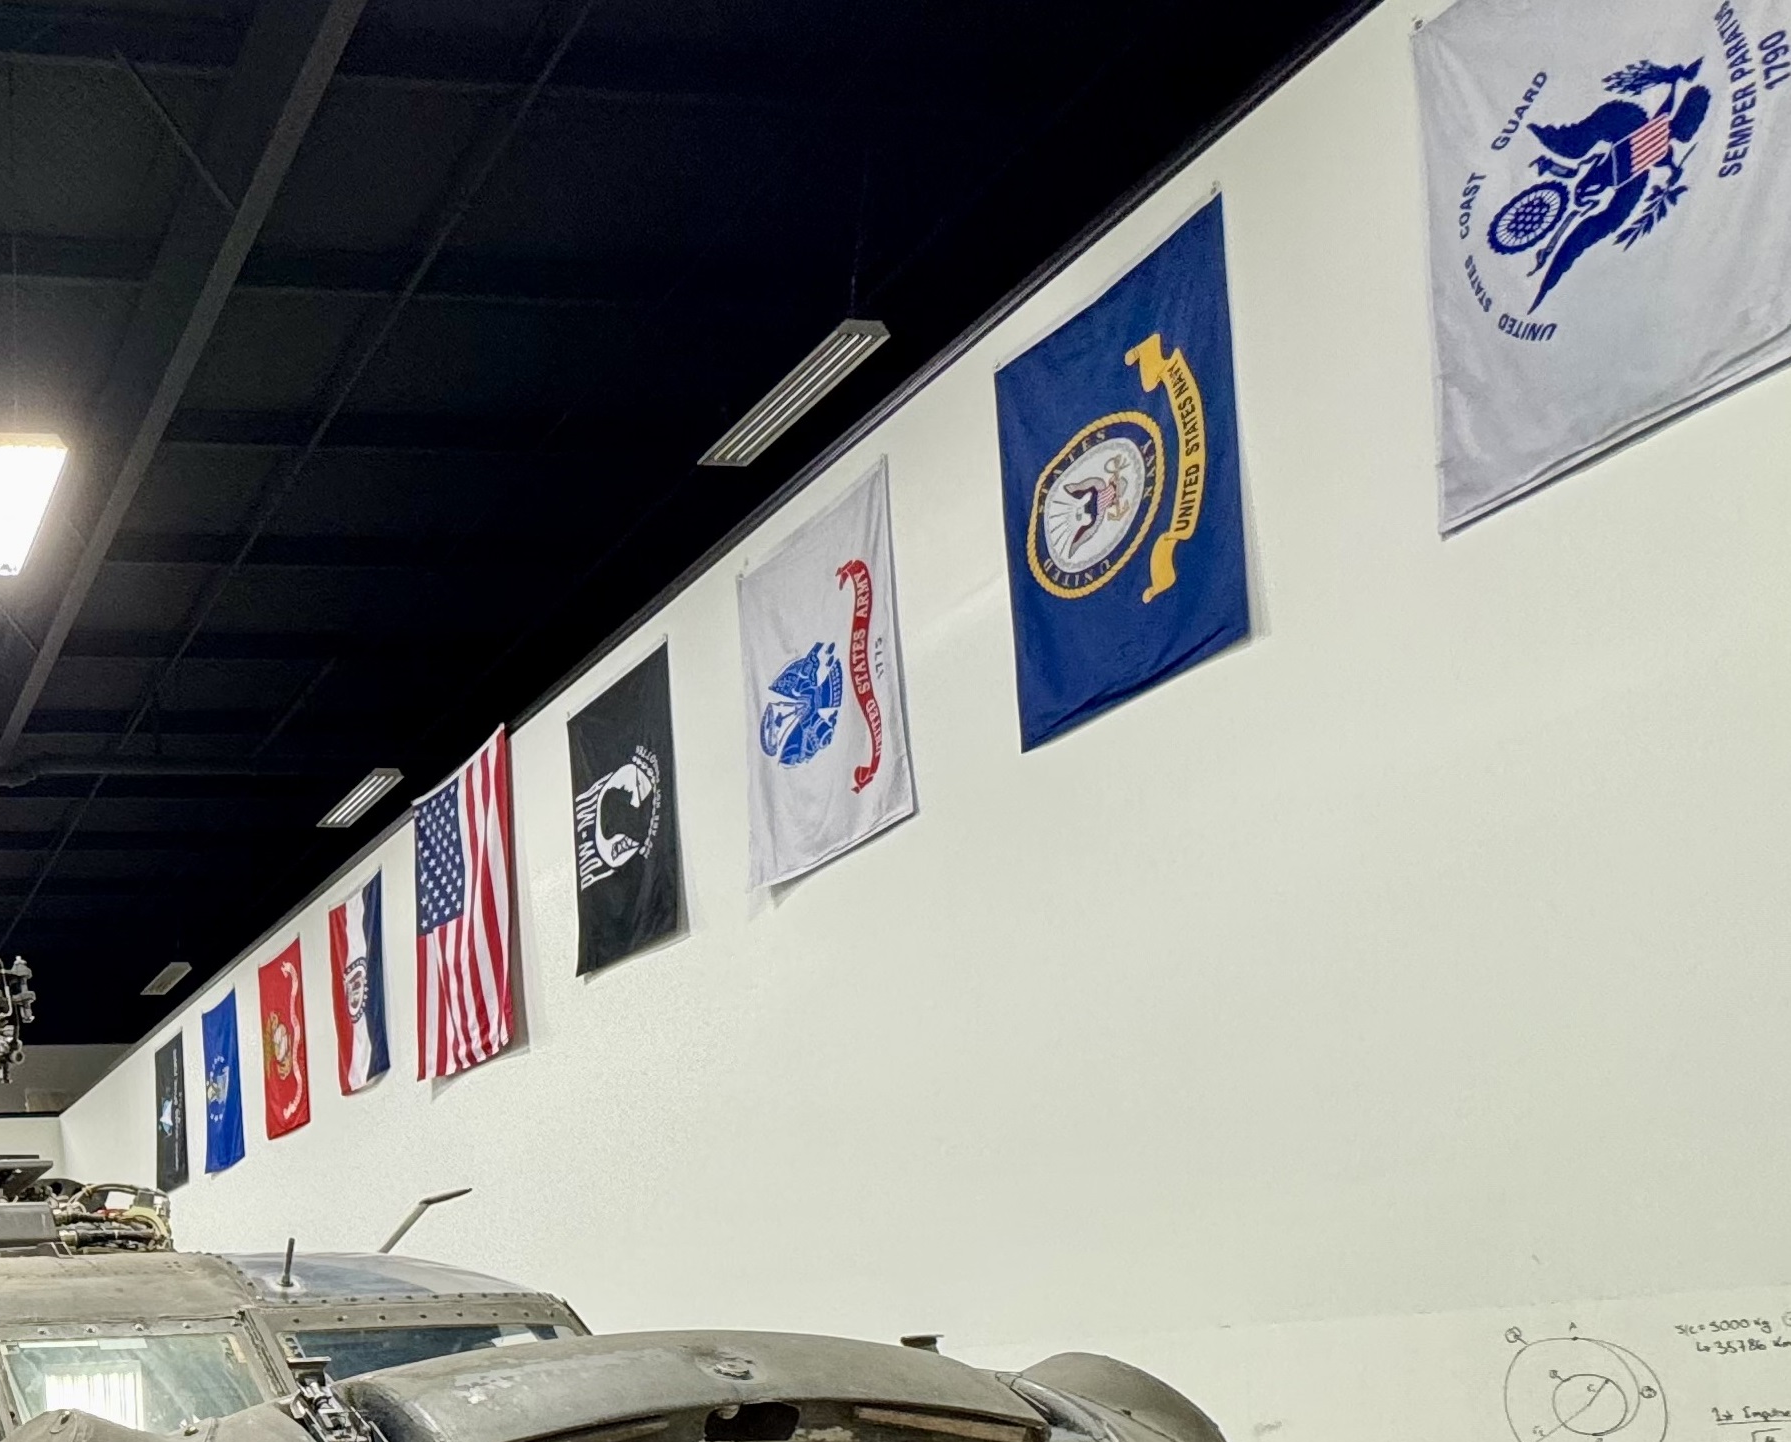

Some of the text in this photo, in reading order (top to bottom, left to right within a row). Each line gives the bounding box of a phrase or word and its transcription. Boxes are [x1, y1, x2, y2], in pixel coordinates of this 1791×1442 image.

[1714, 0, 1757, 178] SEMPER PARATUS
[1758, 30, 1791, 90] 1790
[1459, 71, 1557, 341] UNITED STATES COAST GUARD
[1178, 395, 1200, 457] STATES
[1175, 463, 1200, 532] UNITED
[852, 569, 882, 758] UNITED STATES ARMY
[575, 772, 616, 892] POW MIA
